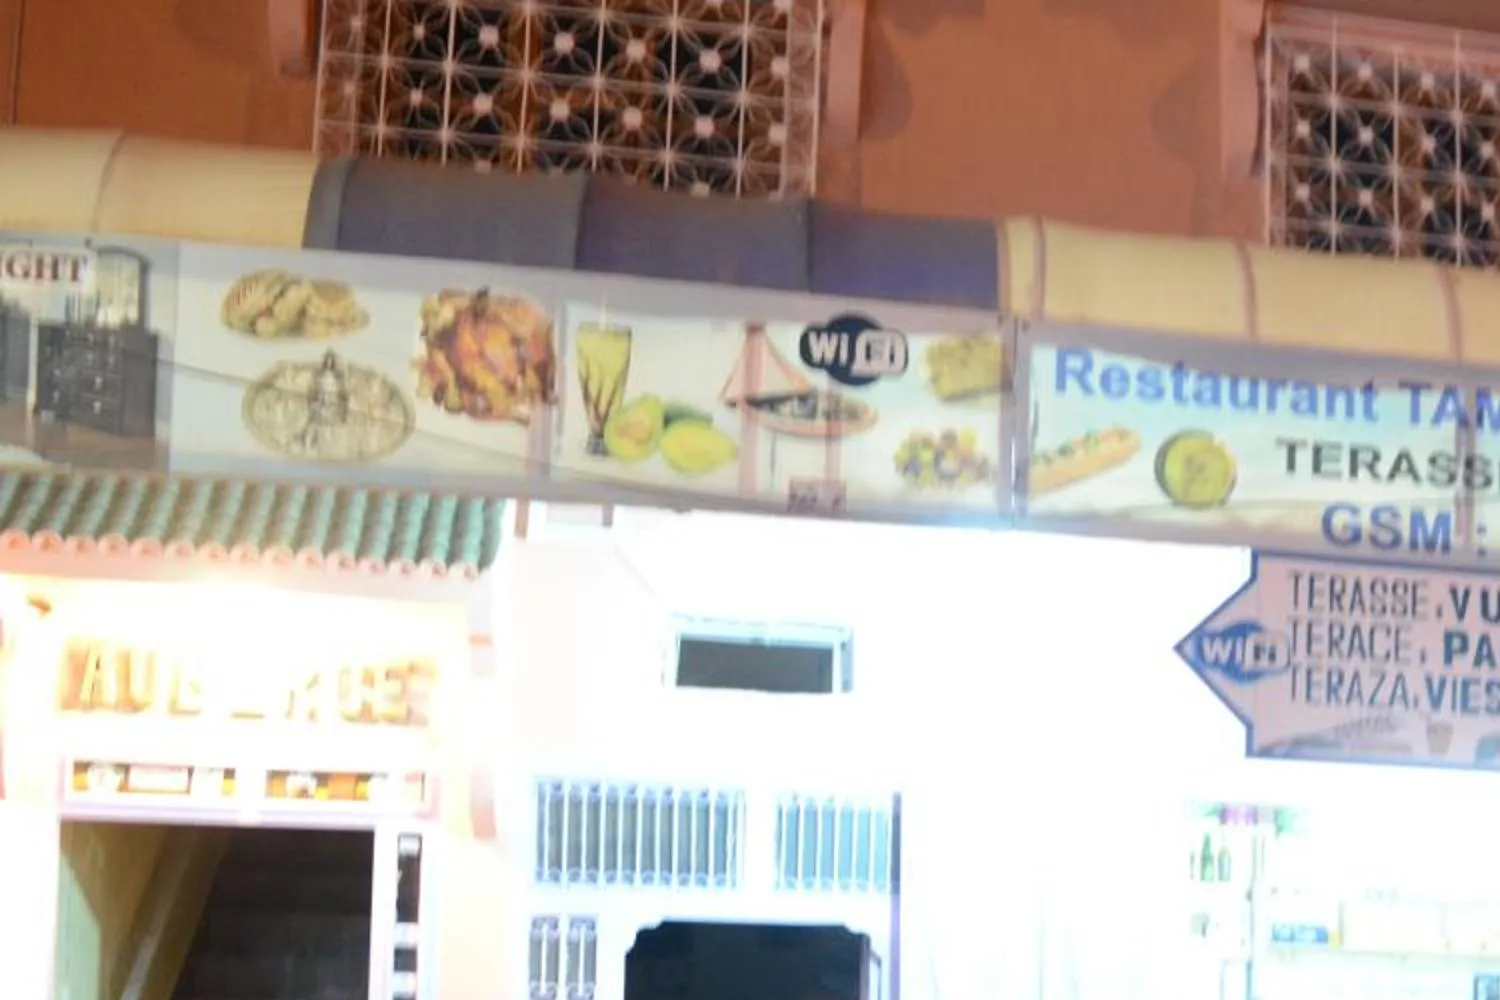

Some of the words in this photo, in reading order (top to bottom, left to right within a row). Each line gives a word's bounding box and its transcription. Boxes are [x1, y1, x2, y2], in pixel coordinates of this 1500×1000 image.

[0, 252, 88, 283] GHT
[1055, 345, 1378, 421] Restaurant
[1321, 503, 1452, 554] GSM
